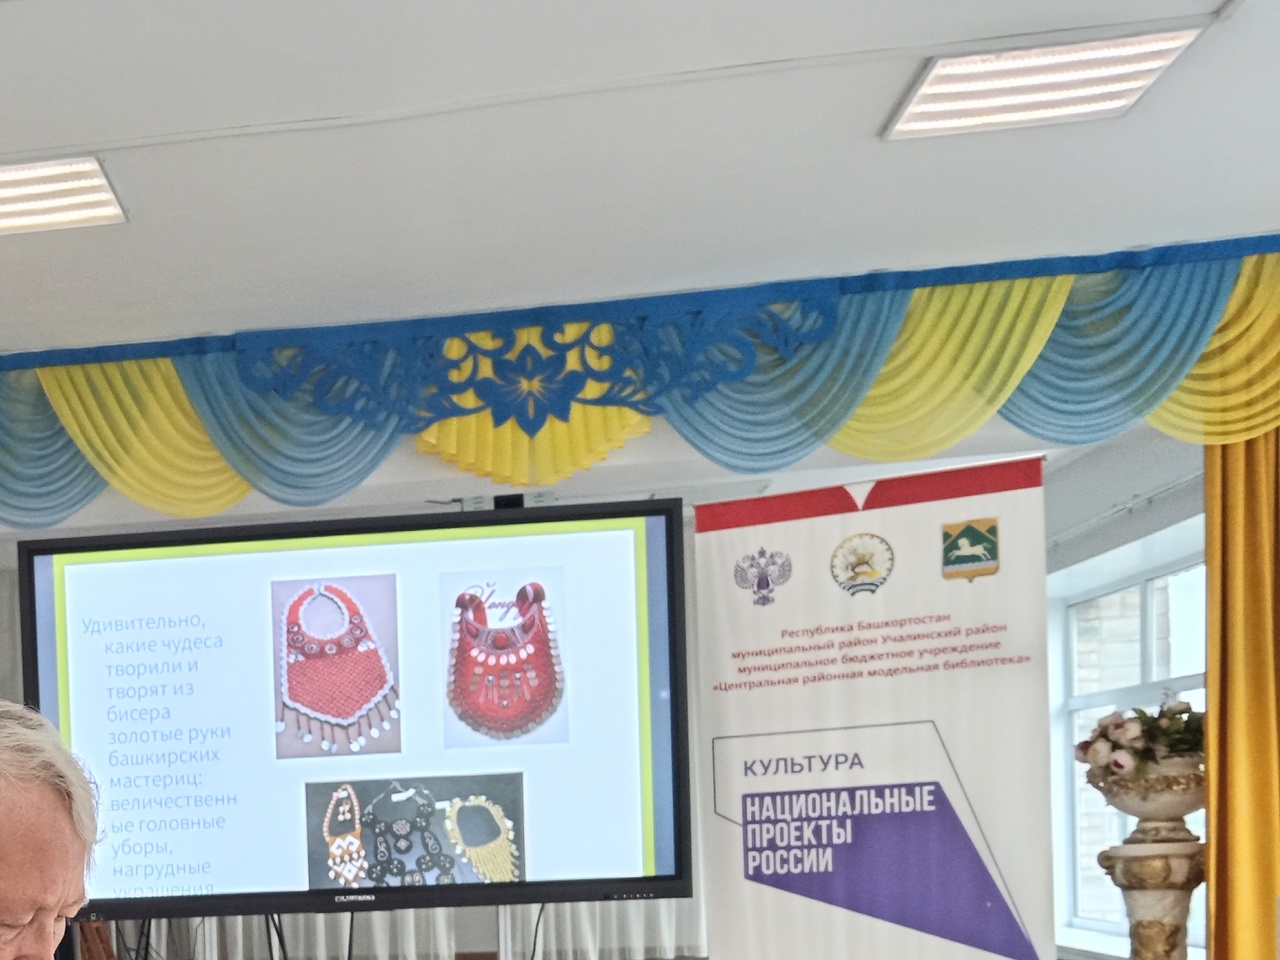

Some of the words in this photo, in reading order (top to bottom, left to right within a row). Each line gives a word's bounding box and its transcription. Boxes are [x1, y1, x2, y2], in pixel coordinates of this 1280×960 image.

[81, 614, 206, 634] Удивительно,
[780, 621, 854, 640] Республика
[857, 612, 951, 633] Башкортостан
[105, 639, 158, 655] какие
[162, 634, 224, 654] чудеса
[731, 641, 835, 661] муниципальный
[838, 635, 878, 652] район
[881, 626, 962, 646] Учалинский
[965, 621, 1007, 639] район
[737, 657, 838, 676] муниципальное
[841, 647, 915, 667] бюджетное
[918, 640, 1002, 659] учреждение
[105, 660, 182, 679] творили
[188, 660, 199, 673] и
[802, 668, 865, 687] районная
[867, 661, 940, 679] модельная
[107, 683, 167, 702] творят
[173, 682, 195, 696] из
[107, 704, 171, 724] бисера
[108, 729, 184, 744] золотые
[188, 727, 232, 745] руки
[108, 748, 220, 768] башкирских
[743, 752, 865, 777] КУЛЬТУРА
[110, 771, 203, 790] мастериц:
[110, 794, 238, 812] величественн
[745, 785, 937, 822] НАЦИОНАЛЬНЫЕ
[111, 820, 134, 833] ые
[138, 815, 226, 832] головные
[746, 820, 853, 849] ПРОЕКТЫ
[111, 838, 173, 857] уборы,
[113, 862, 212, 880] нагрудные
[747, 847, 834, 876] РОССИИ
